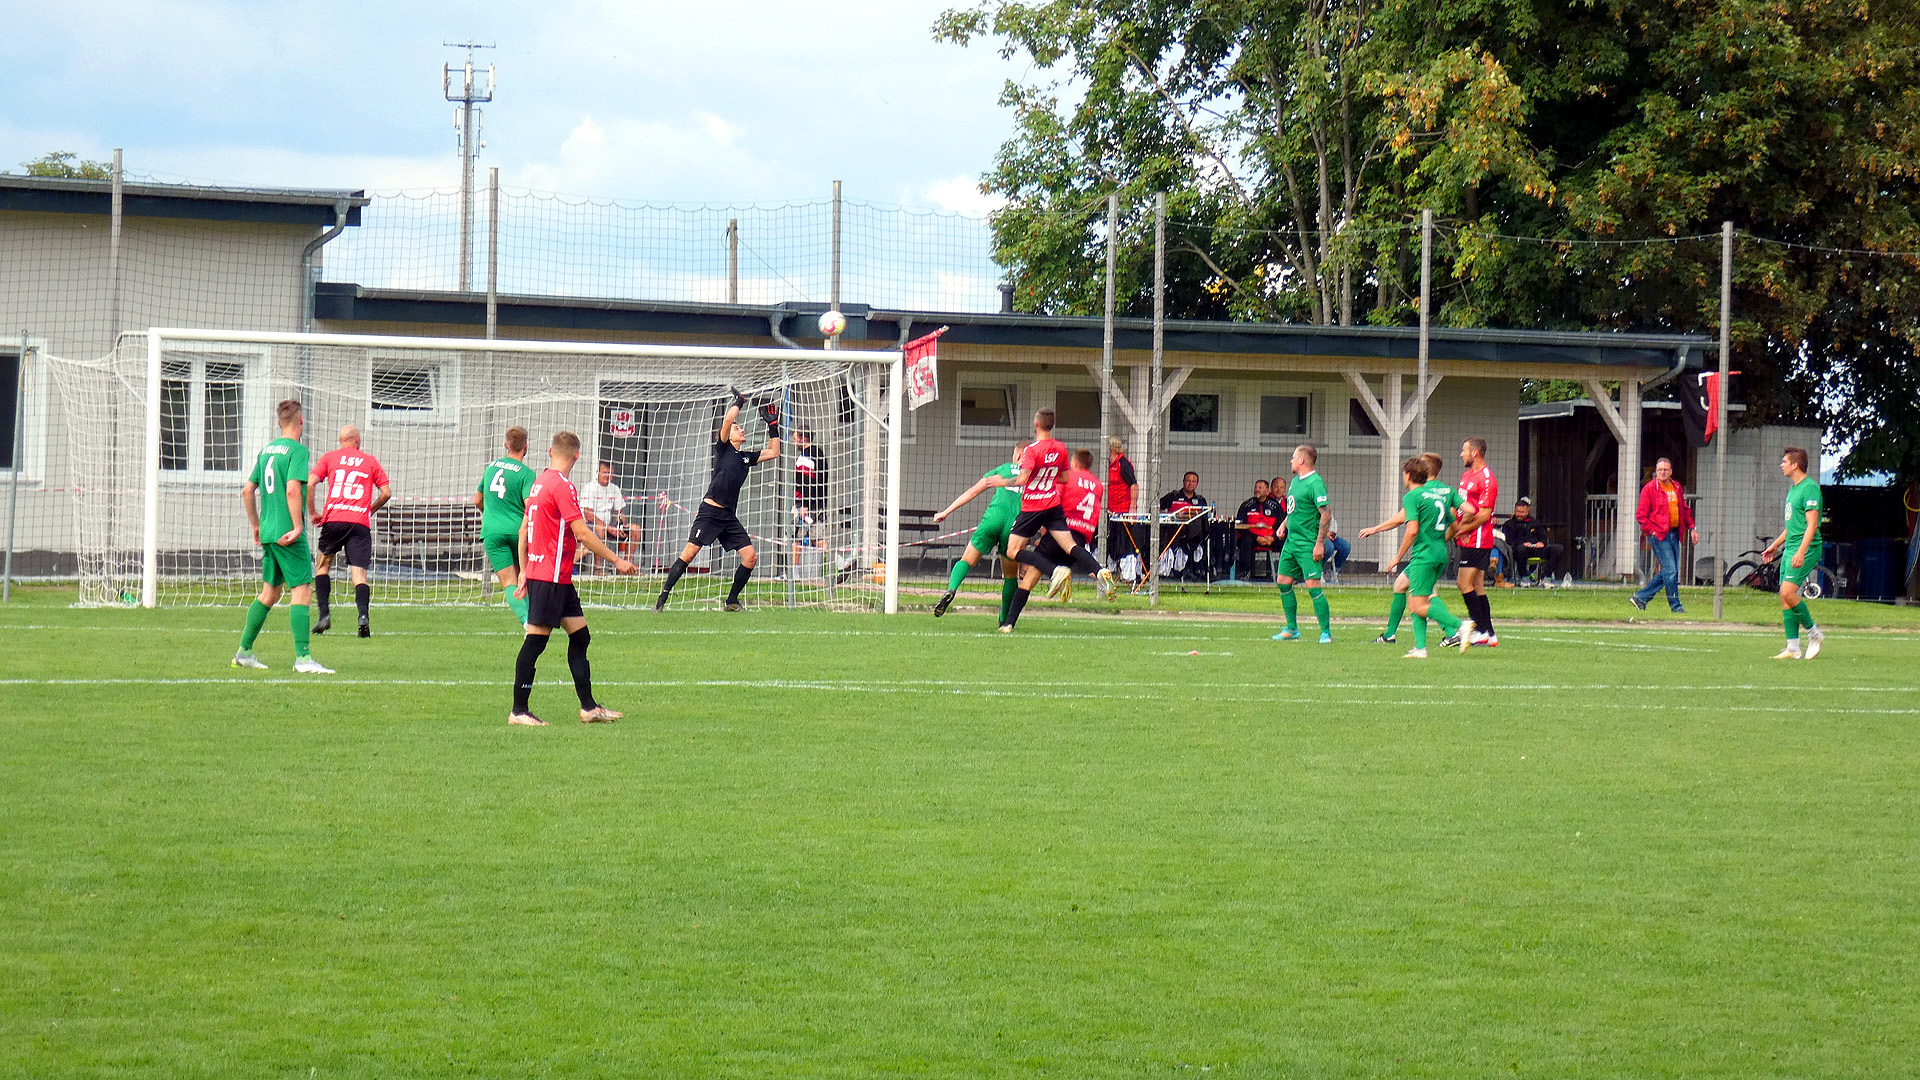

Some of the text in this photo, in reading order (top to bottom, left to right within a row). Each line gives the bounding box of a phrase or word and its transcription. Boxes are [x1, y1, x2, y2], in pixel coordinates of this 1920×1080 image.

[339, 455, 364, 467] LSV
[1044, 452, 1060, 464] LSV
[264, 455, 275, 495] 6
[330, 468, 369, 500] 16
[489, 468, 507, 500] 4
[1026, 466, 1059, 492] 10
[1077, 477, 1096, 491] LSV
[1076, 491, 1096, 521] 4
[1434, 499, 1446, 531] 2
